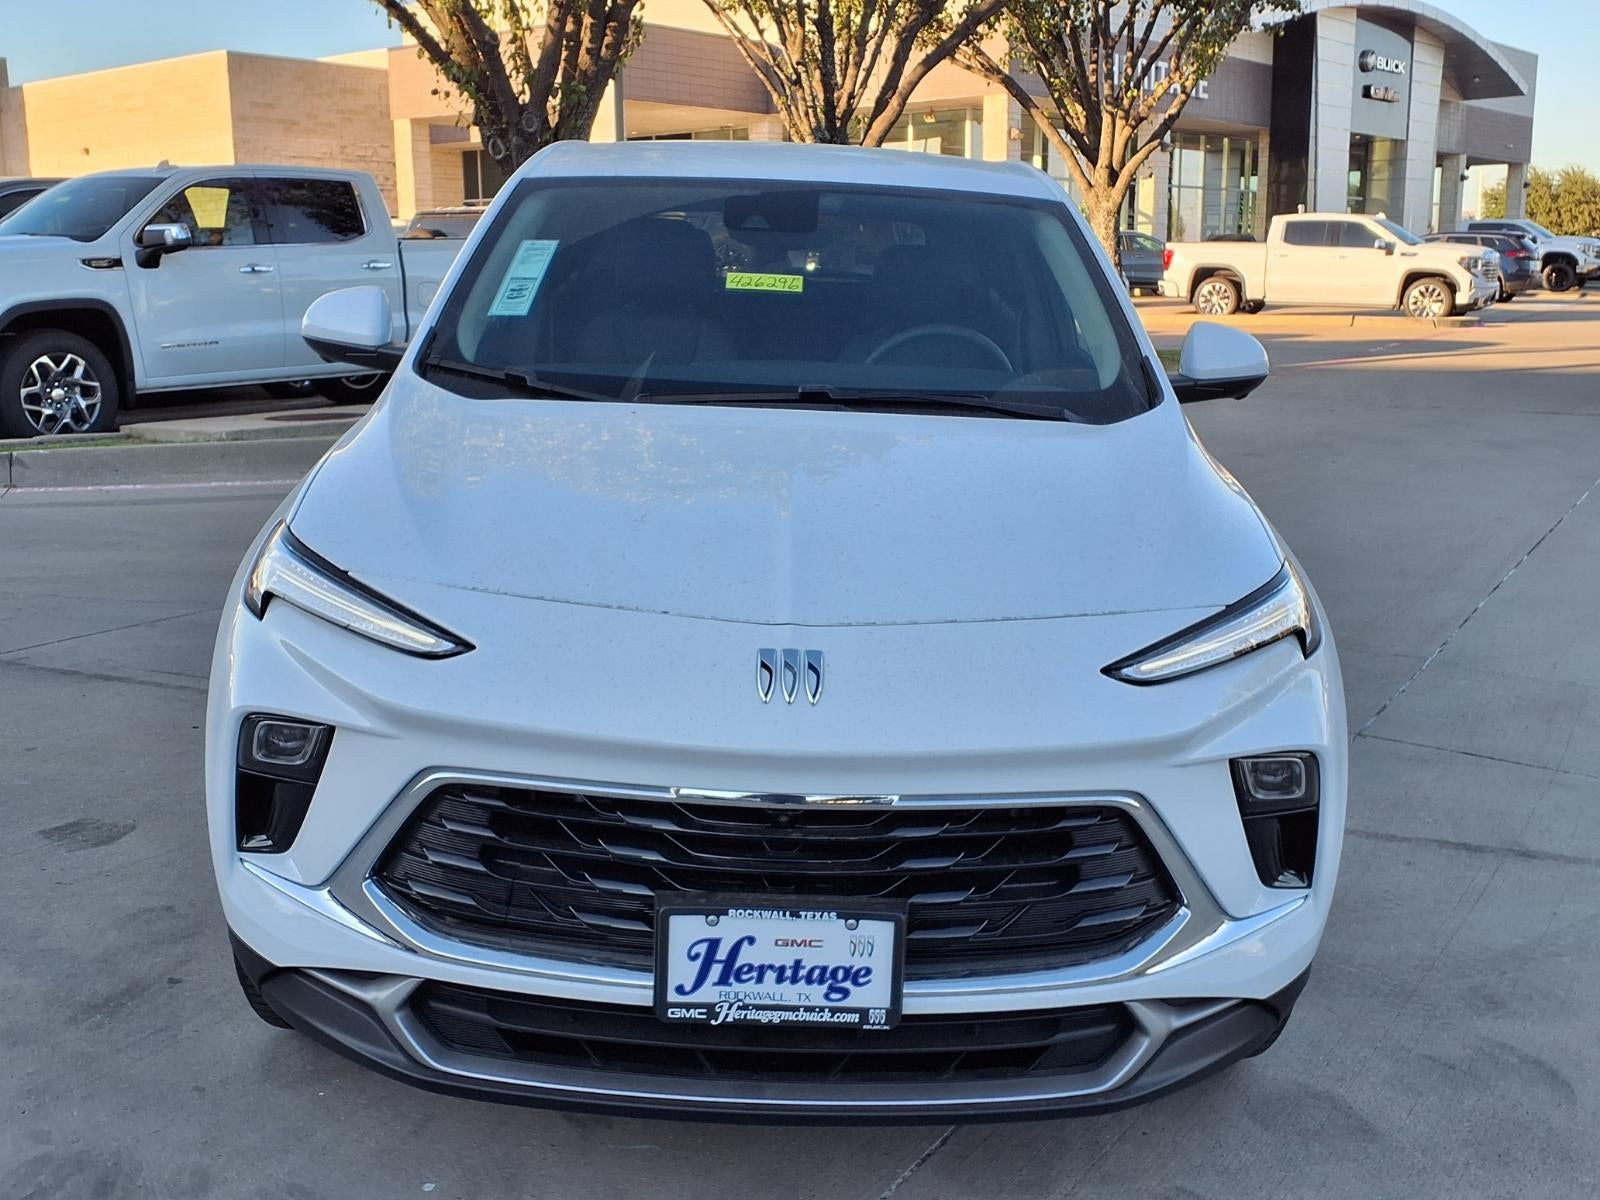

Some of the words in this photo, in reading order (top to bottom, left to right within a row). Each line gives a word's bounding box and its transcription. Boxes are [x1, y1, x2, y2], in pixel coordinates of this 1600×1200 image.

[1376, 56, 1405, 74] BUICK
[728, 909, 796, 920] ROCKWALL,
[799, 911, 838, 921] TEXAS
[774, 938, 824, 948] GMC
[674, 935, 873, 1003] Heritage
[797, 992, 812, 1002] TX
[667, 1008, 708, 1019] GMC
[710, 1001, 860, 1025] Heritagegmcbuick.com
